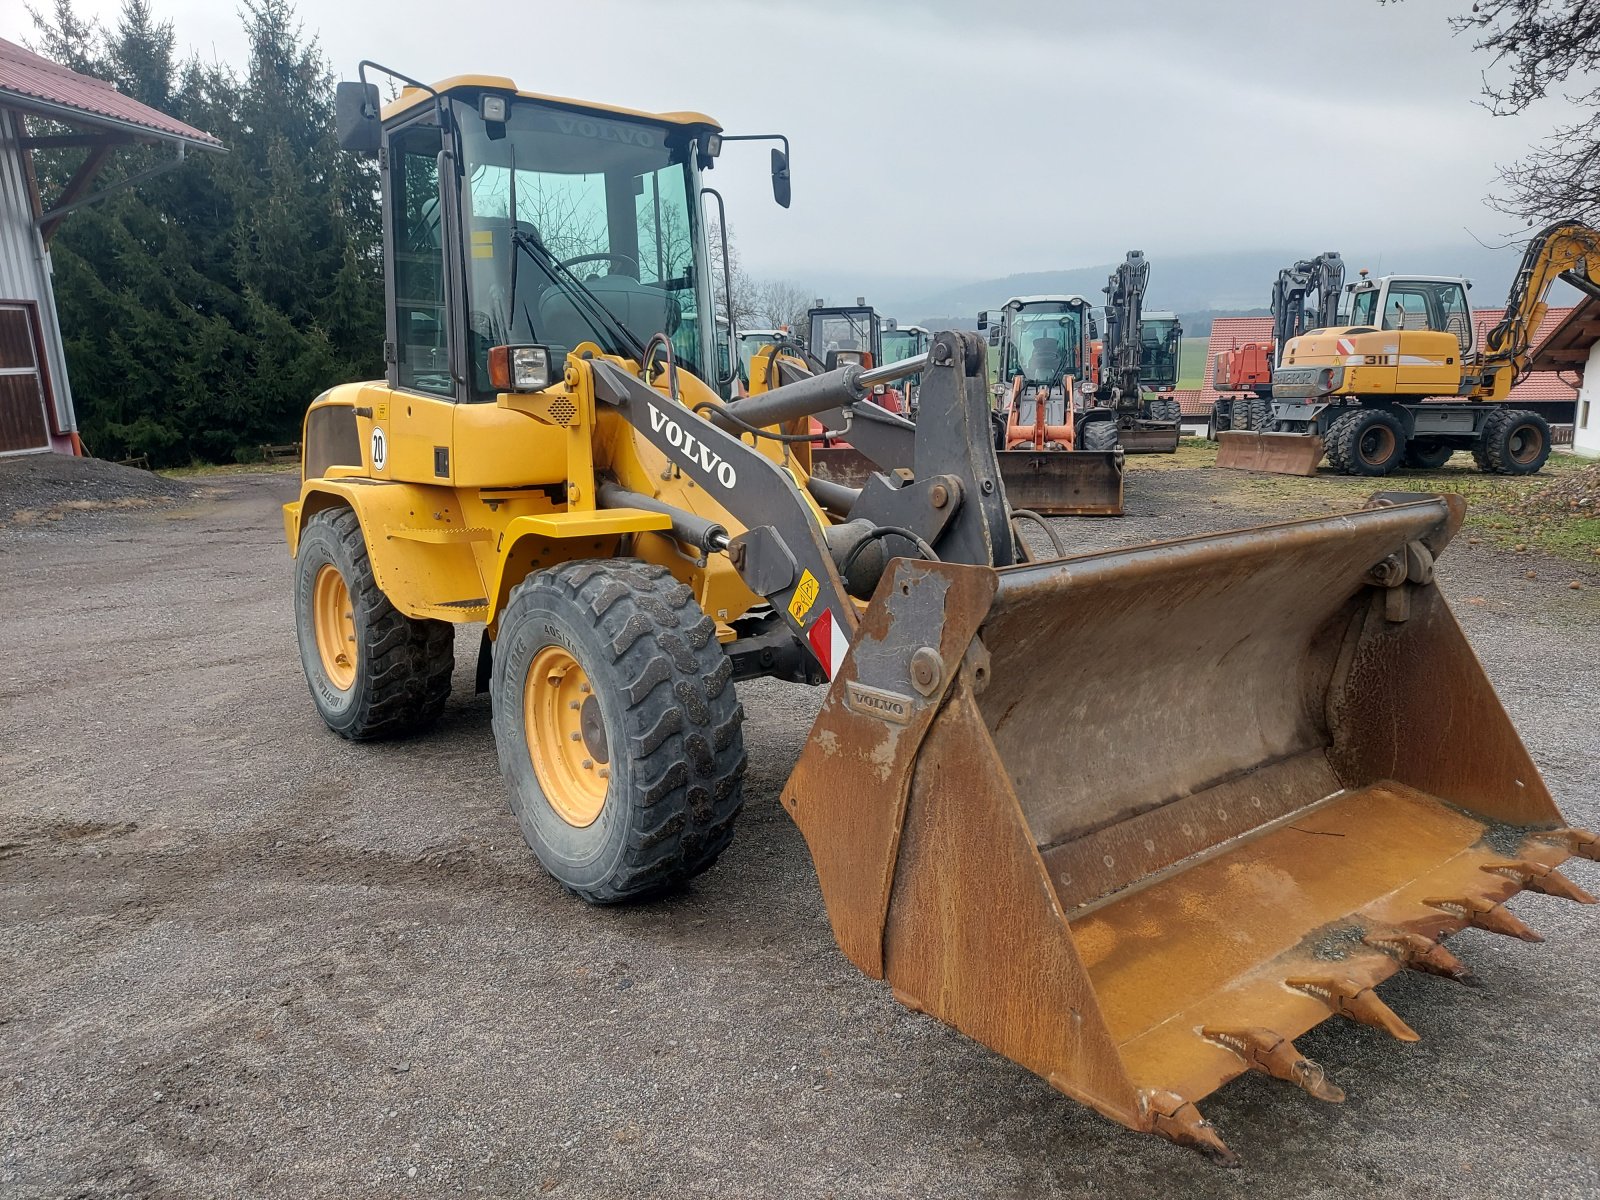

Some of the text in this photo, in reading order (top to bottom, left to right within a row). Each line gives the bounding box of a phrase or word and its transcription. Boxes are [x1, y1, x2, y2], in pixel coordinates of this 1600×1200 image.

[553, 117, 655, 148] VOLVO
[1365, 355, 1388, 365] 311
[373, 435, 383, 463] 20
[647, 402, 737, 489] VOLVO
[852, 692, 904, 715] VOLVO
